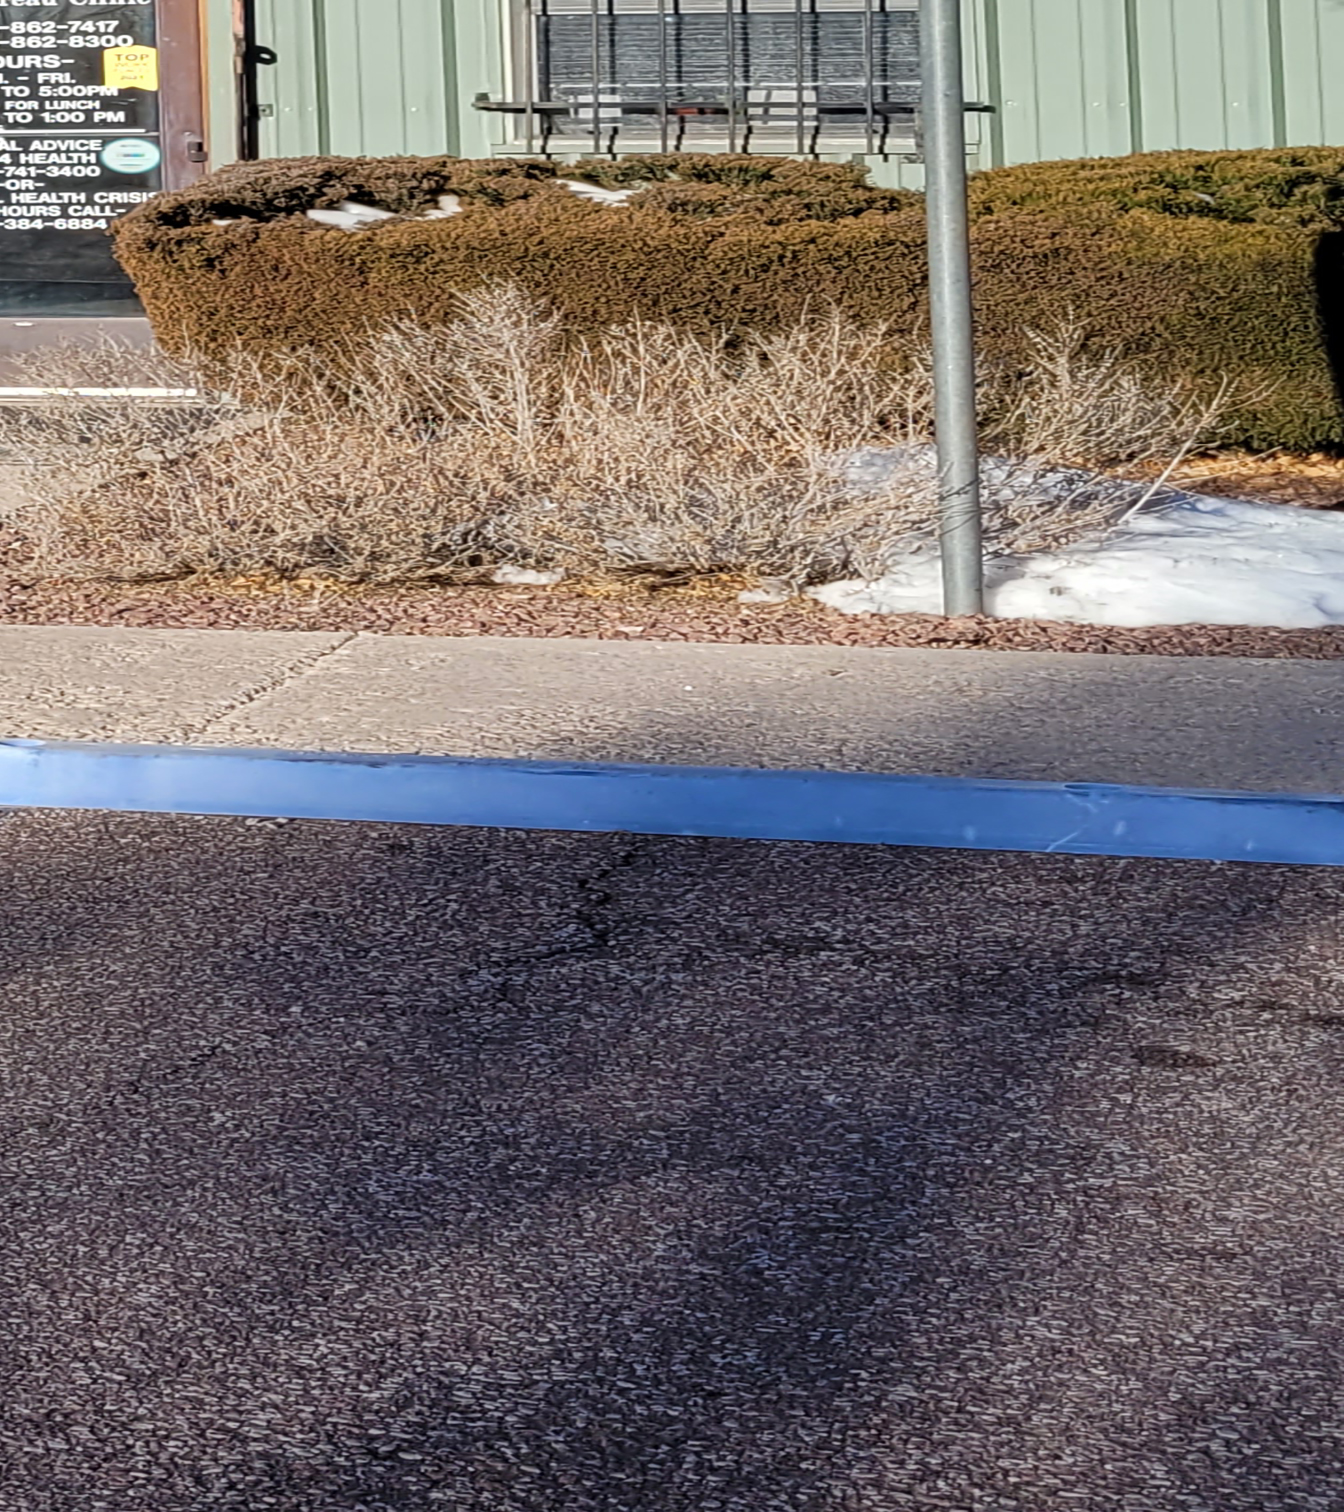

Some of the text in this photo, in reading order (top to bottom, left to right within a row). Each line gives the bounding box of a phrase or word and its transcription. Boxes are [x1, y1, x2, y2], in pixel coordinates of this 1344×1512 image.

[114, 53, 150, 61] TOP
[37, 72, 77, 84] FRI.
[0, 85, 31, 98] TO
[38, 85, 119, 97] 5:00PM
[4, 100, 39, 110] FOR
[44, 100, 101, 110] LUNCH
[2, 111, 33, 124] TO
[39, 111, 86, 123] 1:00
[93, 110, 126, 123] PM
[28, 139, 103, 151] ADVICE
[19, 152, 97, 164] HEALTH
[10, 192, 87, 204] HEALTH
[67, 205, 127, 217] CALL-
